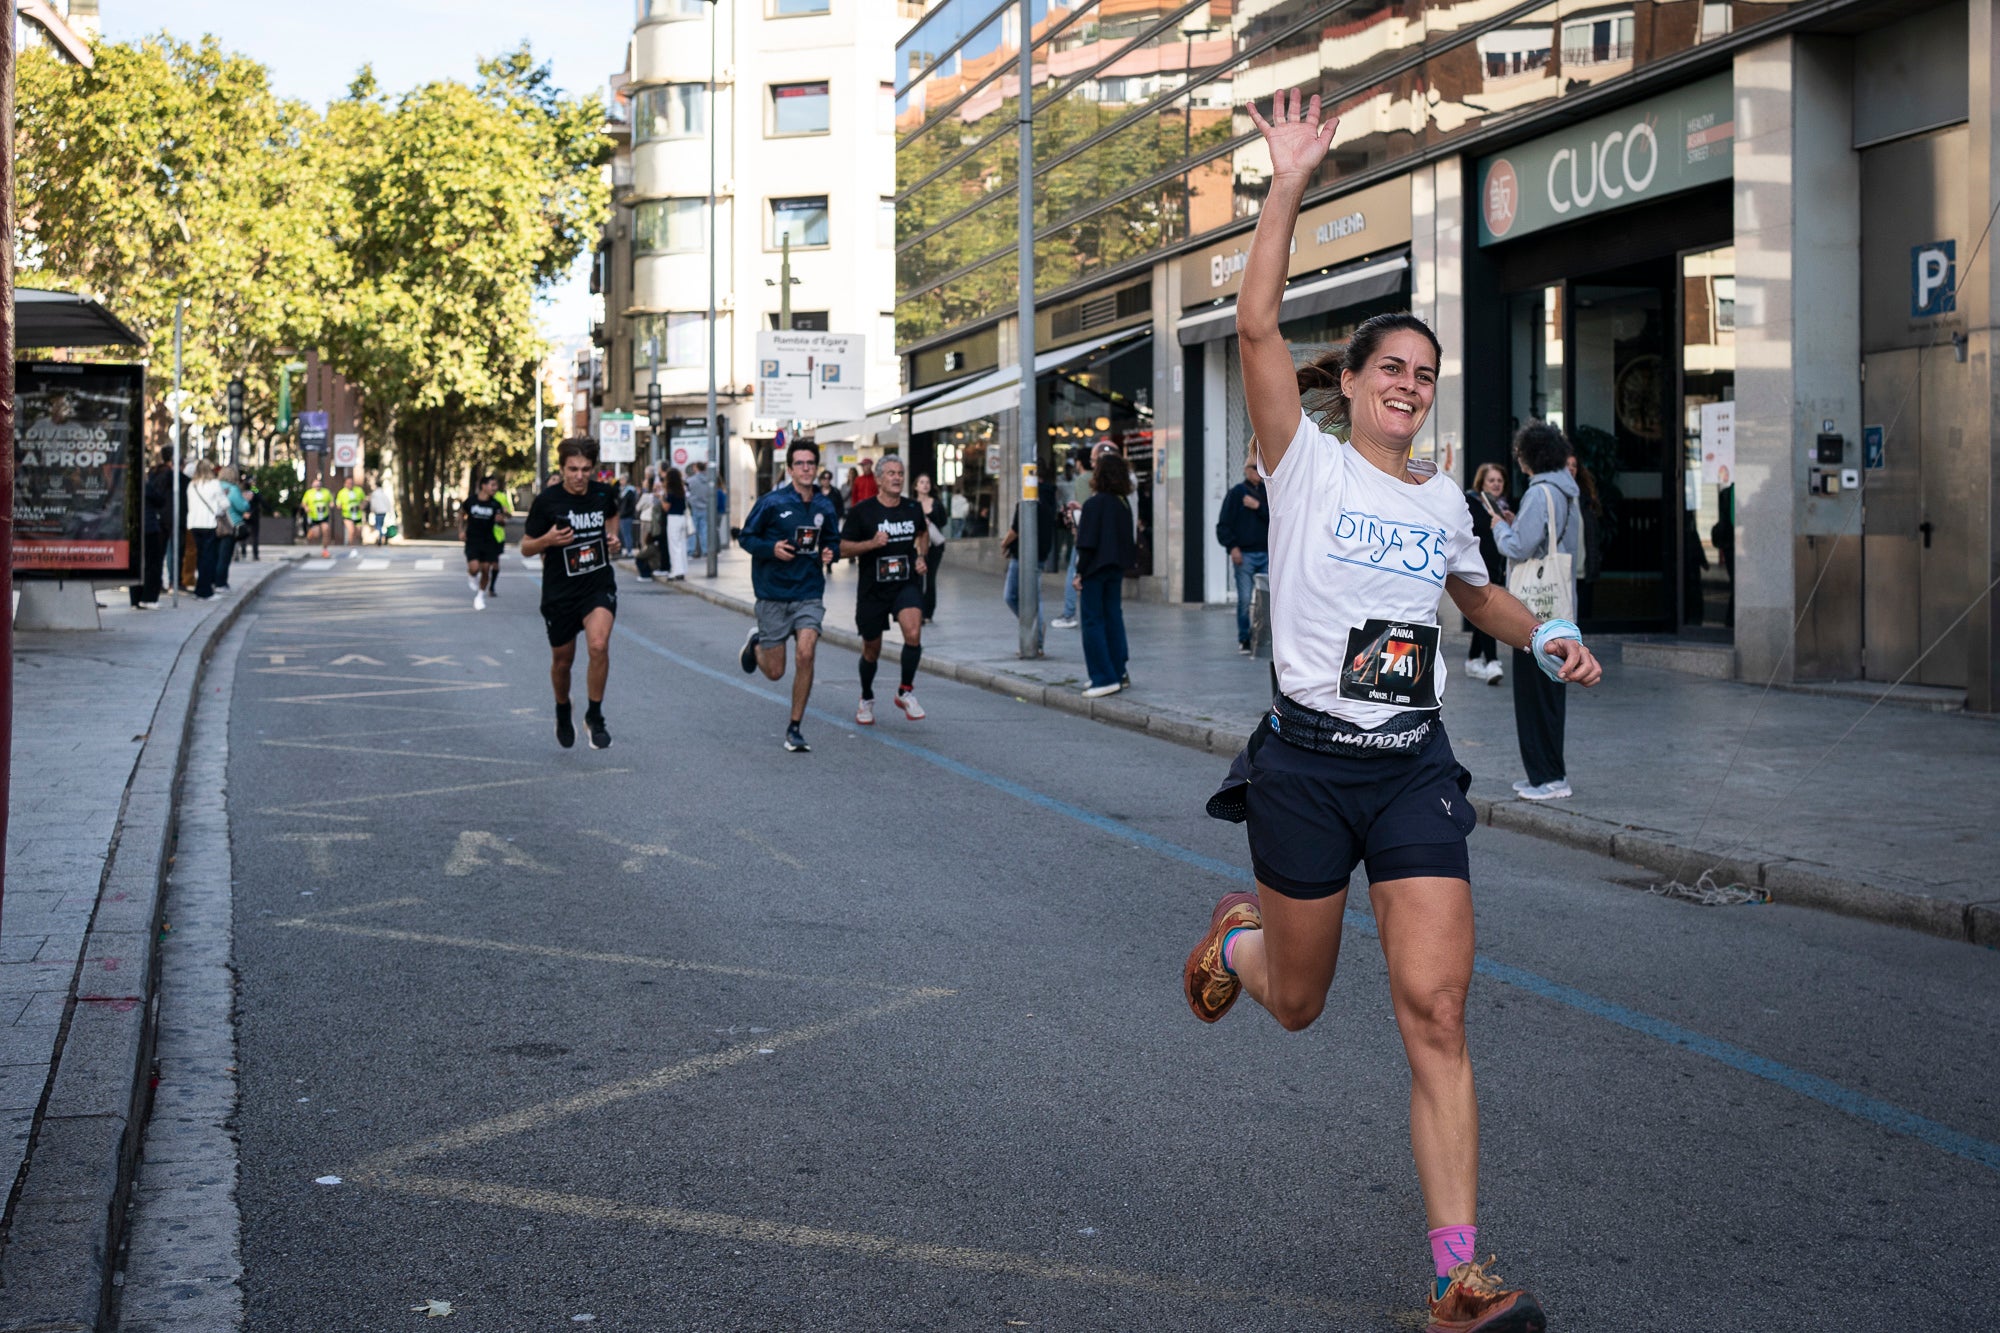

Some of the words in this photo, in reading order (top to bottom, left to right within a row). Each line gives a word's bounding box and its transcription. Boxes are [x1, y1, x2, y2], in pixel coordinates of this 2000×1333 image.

[1547, 122, 1659, 214] CUCO
[1316, 211, 1366, 245] ALTHENA
[773, 336, 810, 345] Rambla
[21, 451, 39, 467] A
[45, 450, 108, 468] PROP
[1389, 627, 1414, 640] ANNA
[1379, 651, 1414, 678] 741
